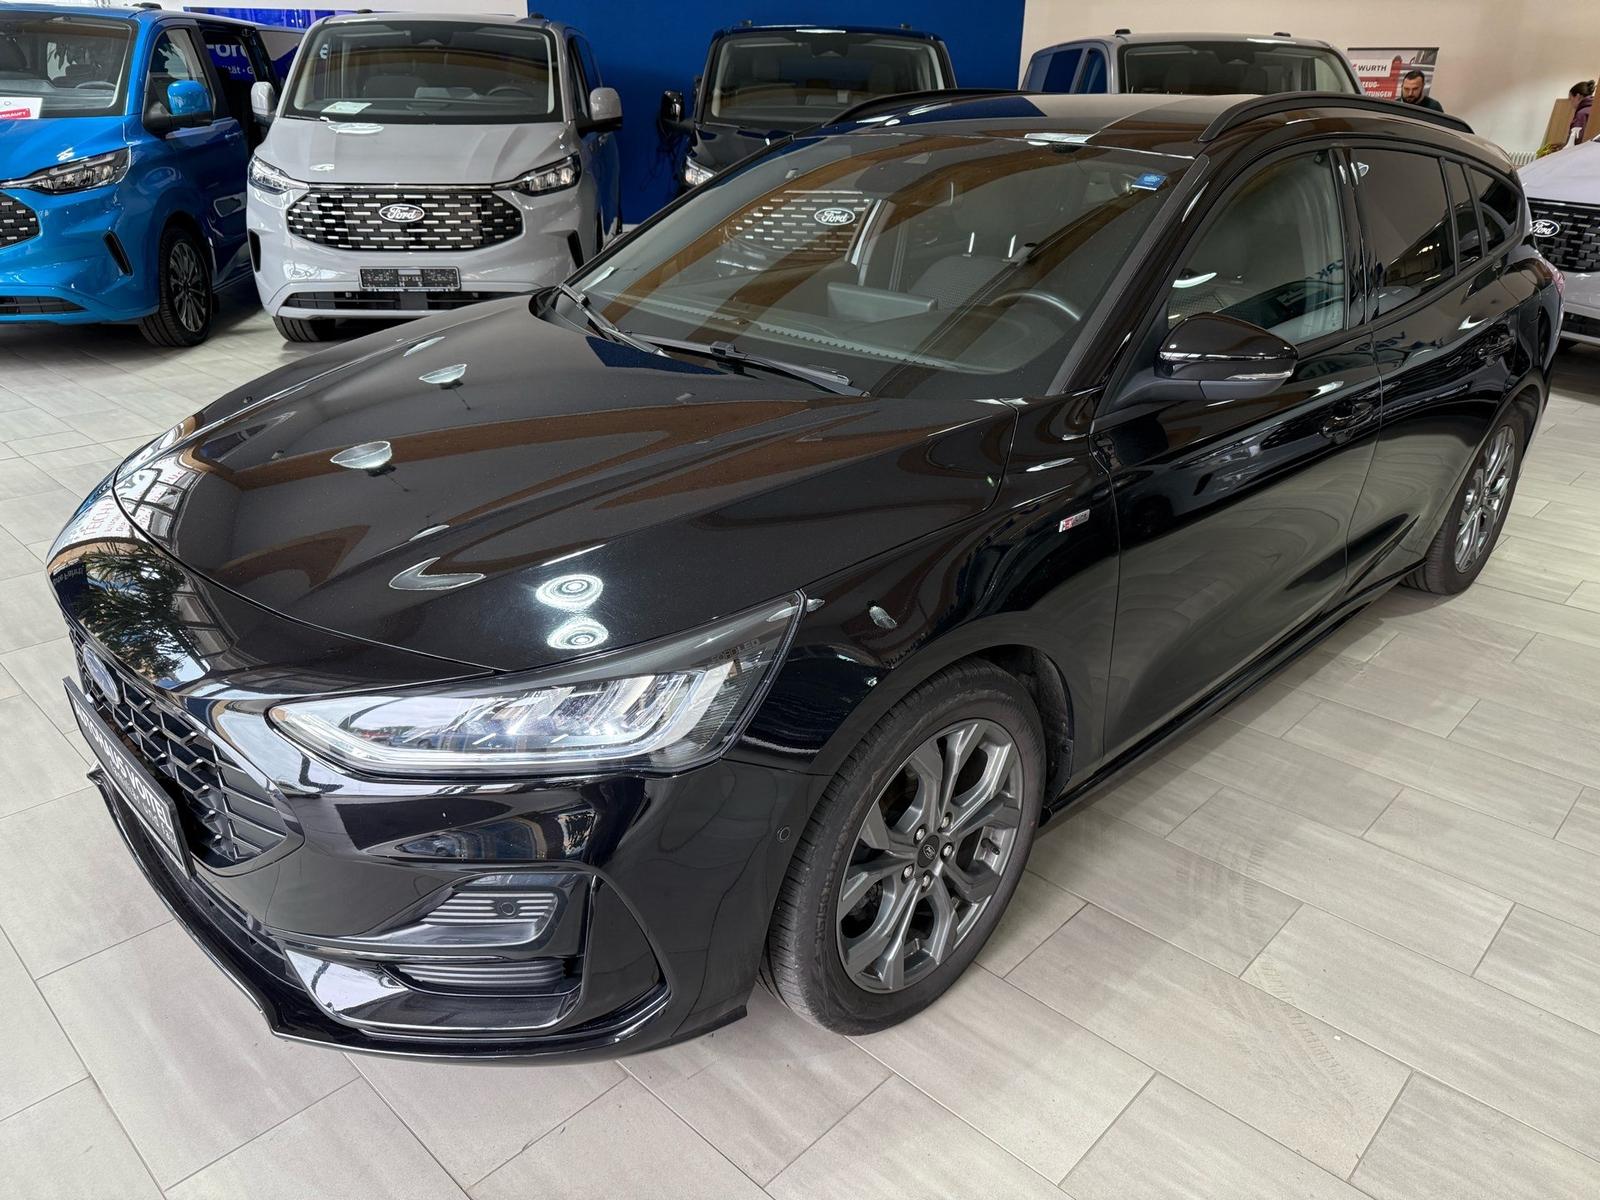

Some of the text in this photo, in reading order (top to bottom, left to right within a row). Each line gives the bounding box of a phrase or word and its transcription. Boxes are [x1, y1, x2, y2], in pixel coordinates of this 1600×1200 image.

[386, 206, 417, 219] Ford
[821, 210, 848, 222] Ford
[125, 764, 174, 833] VOITEL
